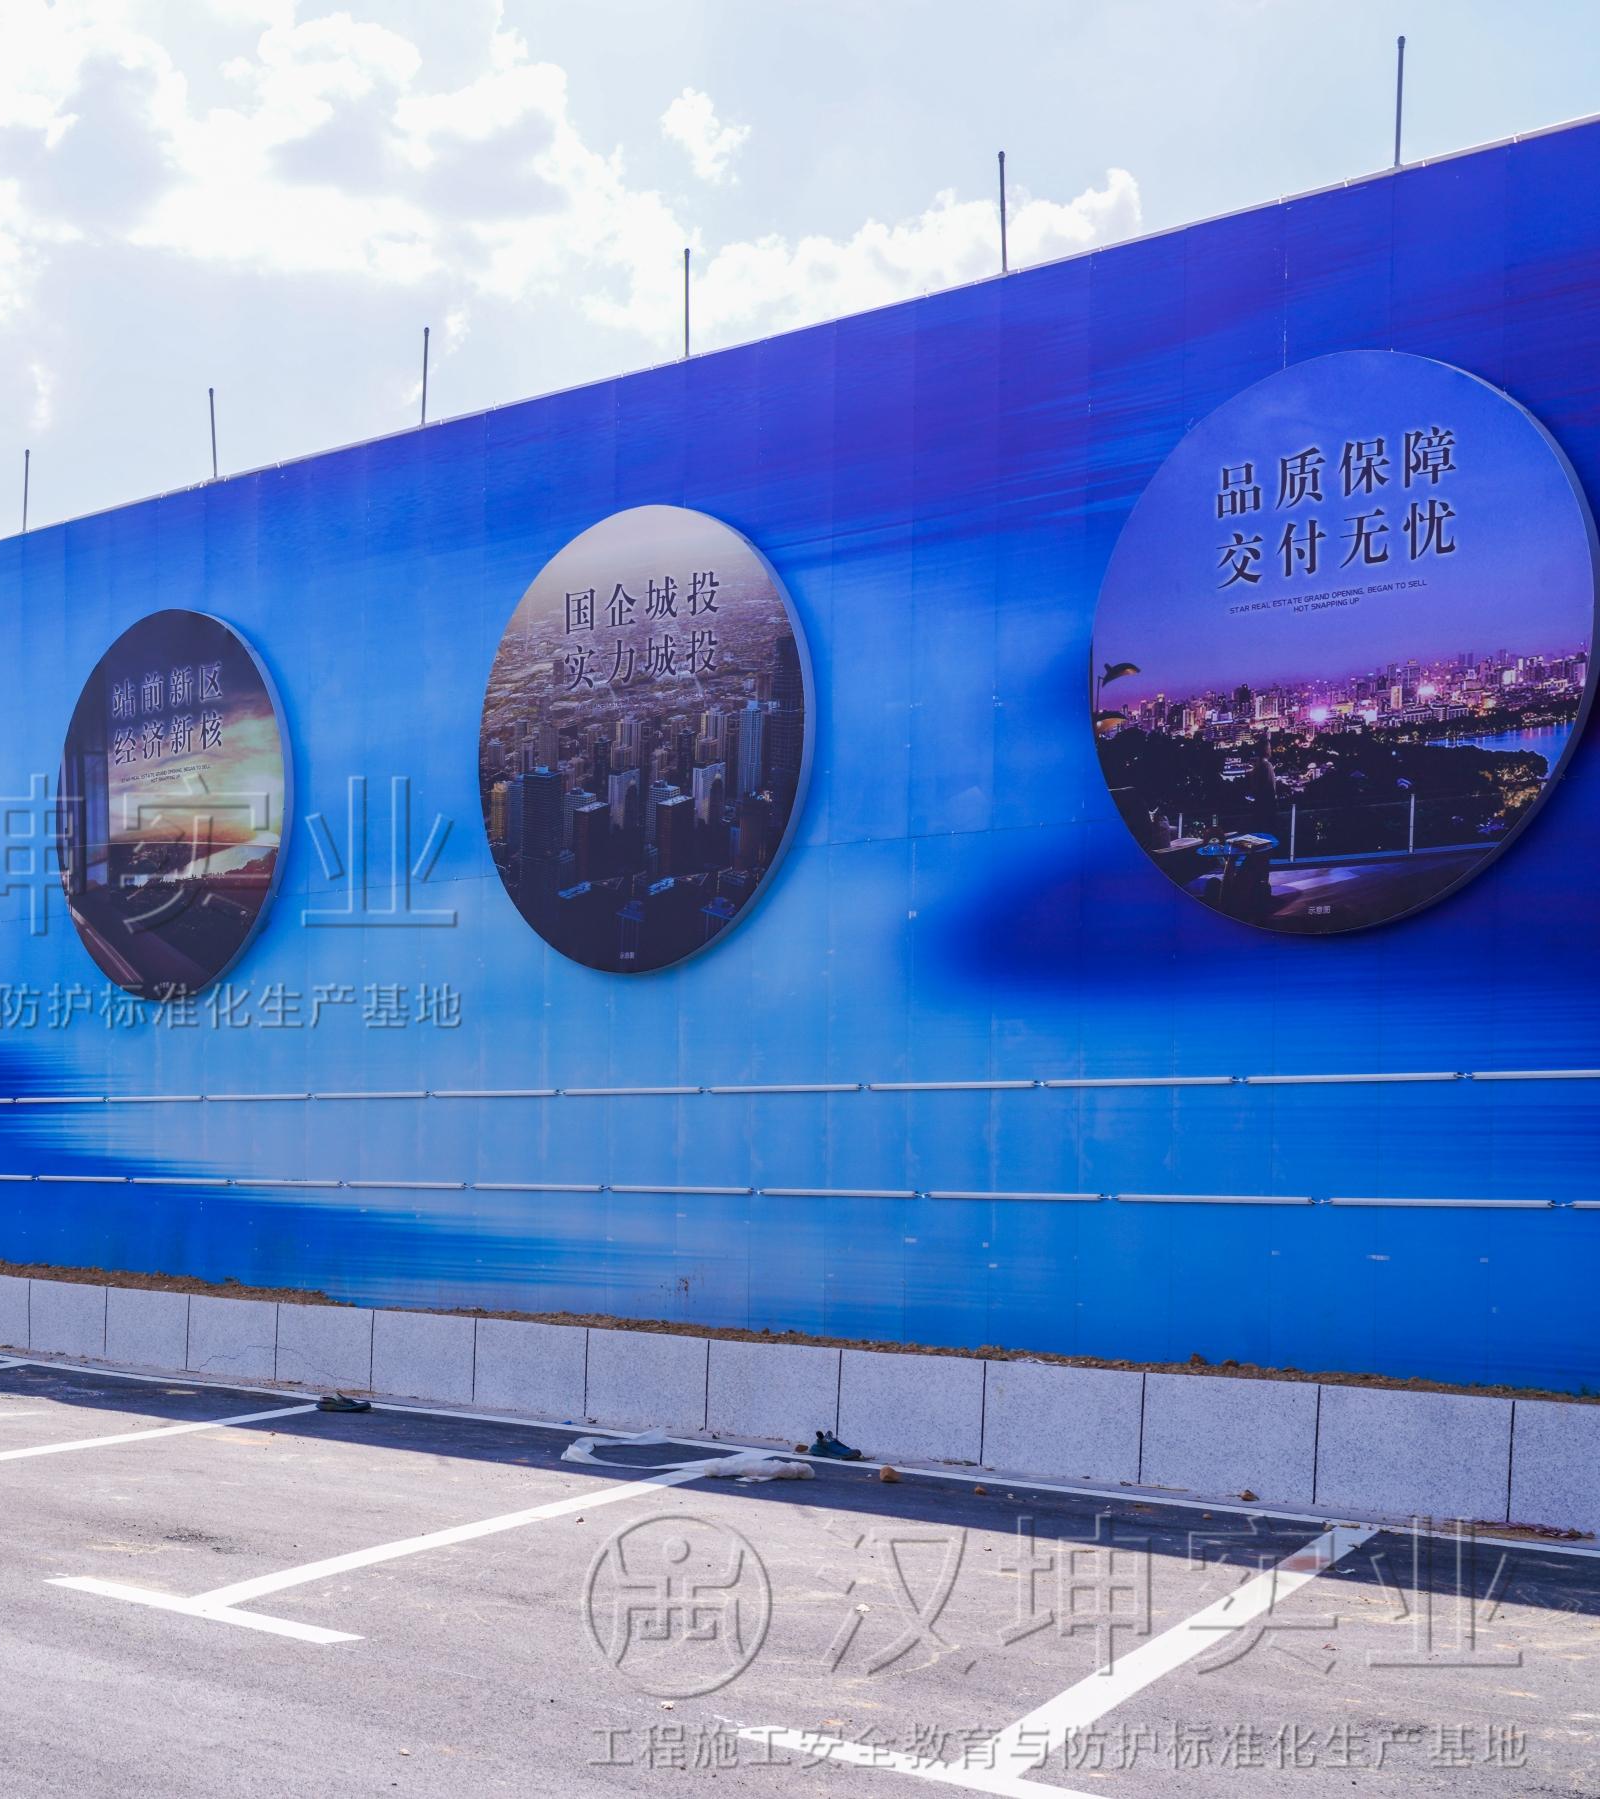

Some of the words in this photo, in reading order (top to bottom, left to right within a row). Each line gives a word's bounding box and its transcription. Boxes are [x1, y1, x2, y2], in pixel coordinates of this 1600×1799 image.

[1216, 427, 1457, 518] 品质保障
[1216, 499, 1457, 589] 交付无忧
[564, 570, 720, 635] 国企城投
[1230, 605, 1250, 614] STAR
[1252, 603, 1270, 611] REAL
[1273, 597, 1302, 608] ESTATE
[1304, 593, 1329, 603] GRAND
[1367, 584, 1393, 594] BEGAN
[1408, 580, 1427, 588] SELL
[1293, 605, 1308, 613] HOT
[1311, 599, 1348, 611] SNAPPING
[1349, 597, 1360, 605] UP
[564, 629, 718, 690] 实力城投
[112, 661, 223, 717] 站前新区
[113, 712, 223, 766] 经济新核
